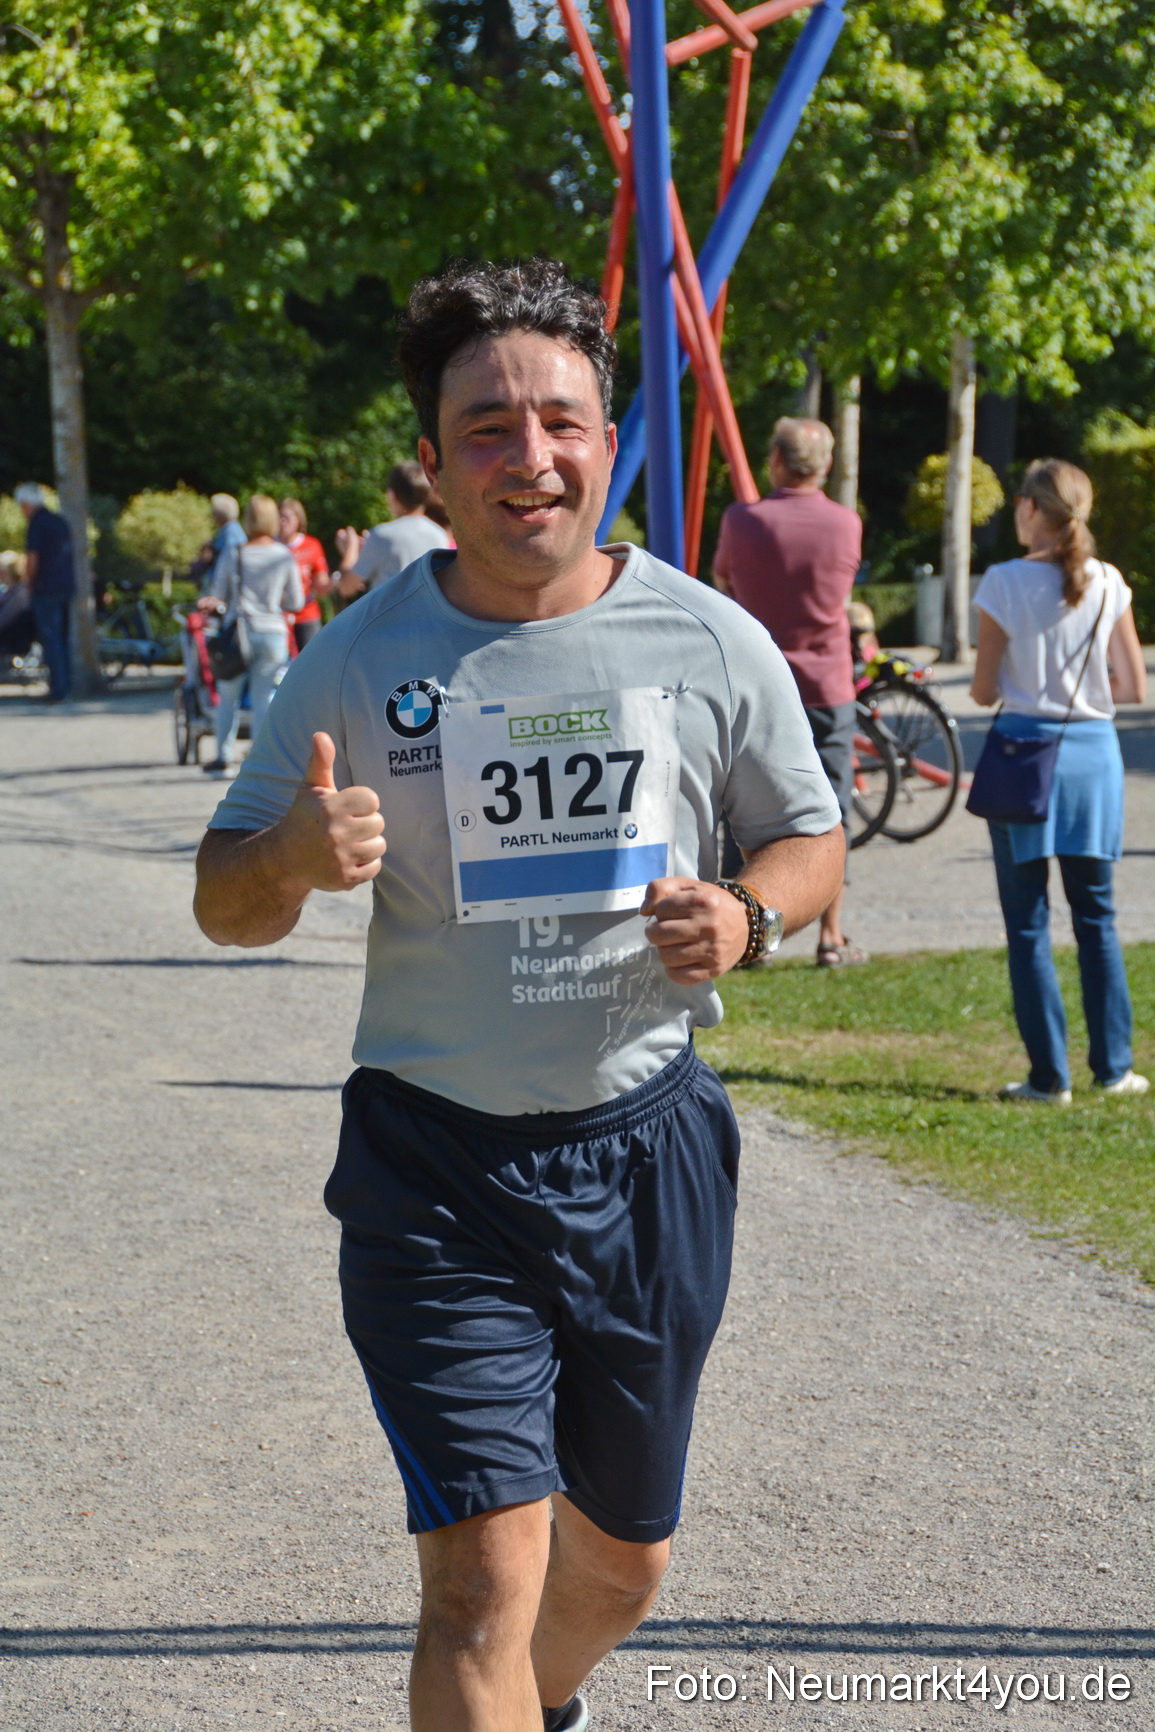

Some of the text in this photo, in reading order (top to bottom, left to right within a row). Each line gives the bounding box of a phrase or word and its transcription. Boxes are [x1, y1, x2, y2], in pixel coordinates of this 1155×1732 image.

[391, 681, 439, 703] BMW
[509, 709, 610, 739] BOCK
[388, 745, 442, 766] PARTL
[510, 733, 612, 748] inspired by smart concepts
[390, 760, 442, 778] Neumark
[480, 749, 645, 826] 3127
[500, 827, 619, 849] PARTL Neumarkt
[512, 915, 574, 949] 19.
[511, 944, 643, 975] Neumarkter
[512, 973, 622, 1004] Stadtlauf
[613, 994, 646, 1047] September
[644, 968, 657, 995] 2018
